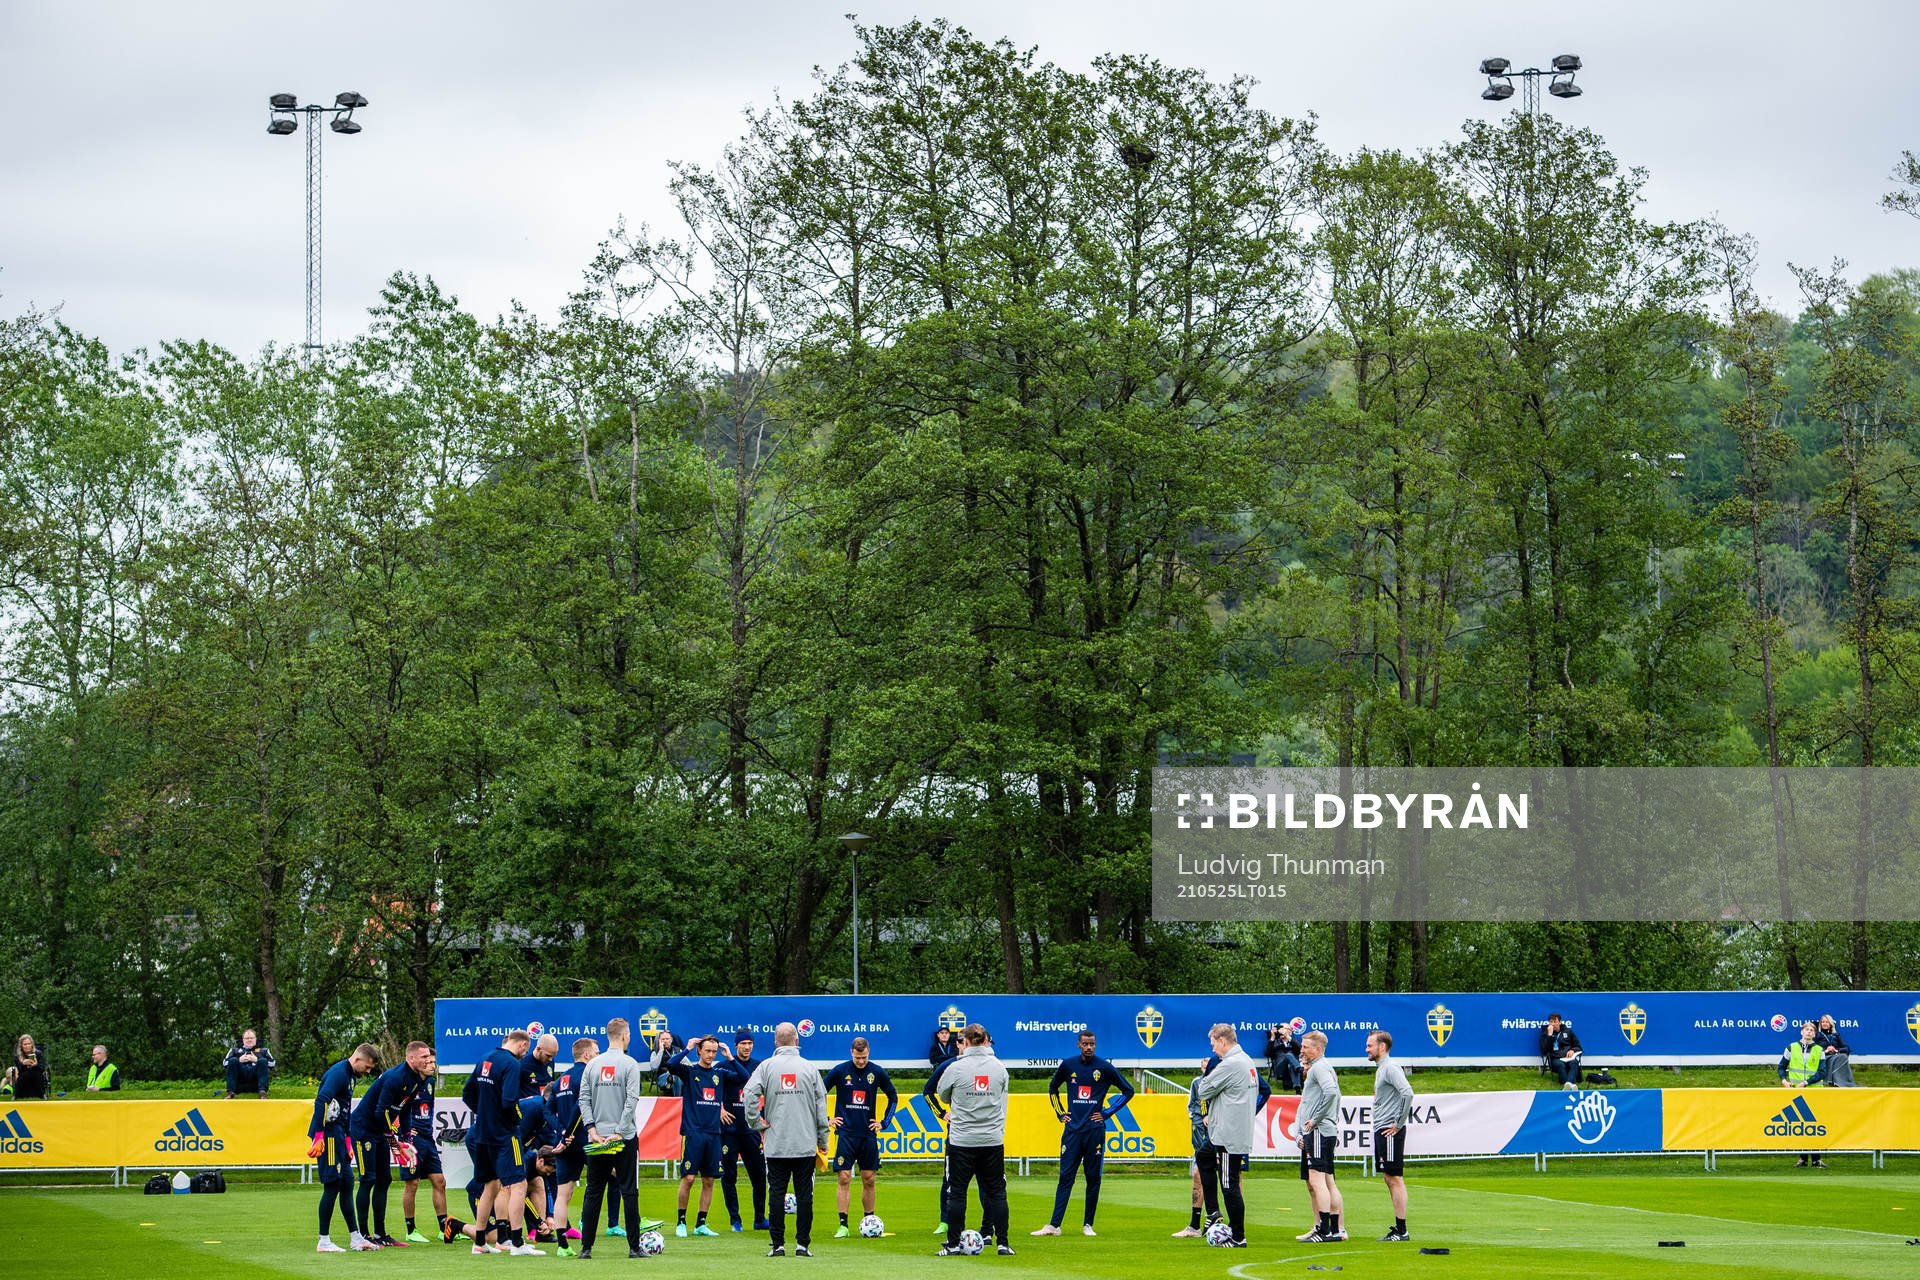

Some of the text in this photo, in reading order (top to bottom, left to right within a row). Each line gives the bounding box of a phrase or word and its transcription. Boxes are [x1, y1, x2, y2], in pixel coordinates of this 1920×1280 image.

[820, 1023, 890, 1033] OLIKA ÄR BRA
[1015, 1021, 1087, 1033] #viärsverige
[1239, 1021, 1253, 1030] ÄR
[1311, 1020, 1379, 1030] OLIKA ÄR BRA
[1694, 1018, 1766, 1028] ALLA ÄR OLIKA
[1839, 1019, 1859, 1028] BRA
[445, 1028, 472, 1036] ALLA
[474, 1026, 488, 1036] ÄR
[549, 1026, 581, 1035] OLIKA
[583, 1025, 597, 1035] ÄR
[717, 1025, 742, 1033] ALL
[1027, 1058, 1059, 1066] SKIVOR
[1763, 1122, 1827, 1137] adidas
[0, 1138, 44, 1154] idas
[154, 1136, 224, 1152] adidas
